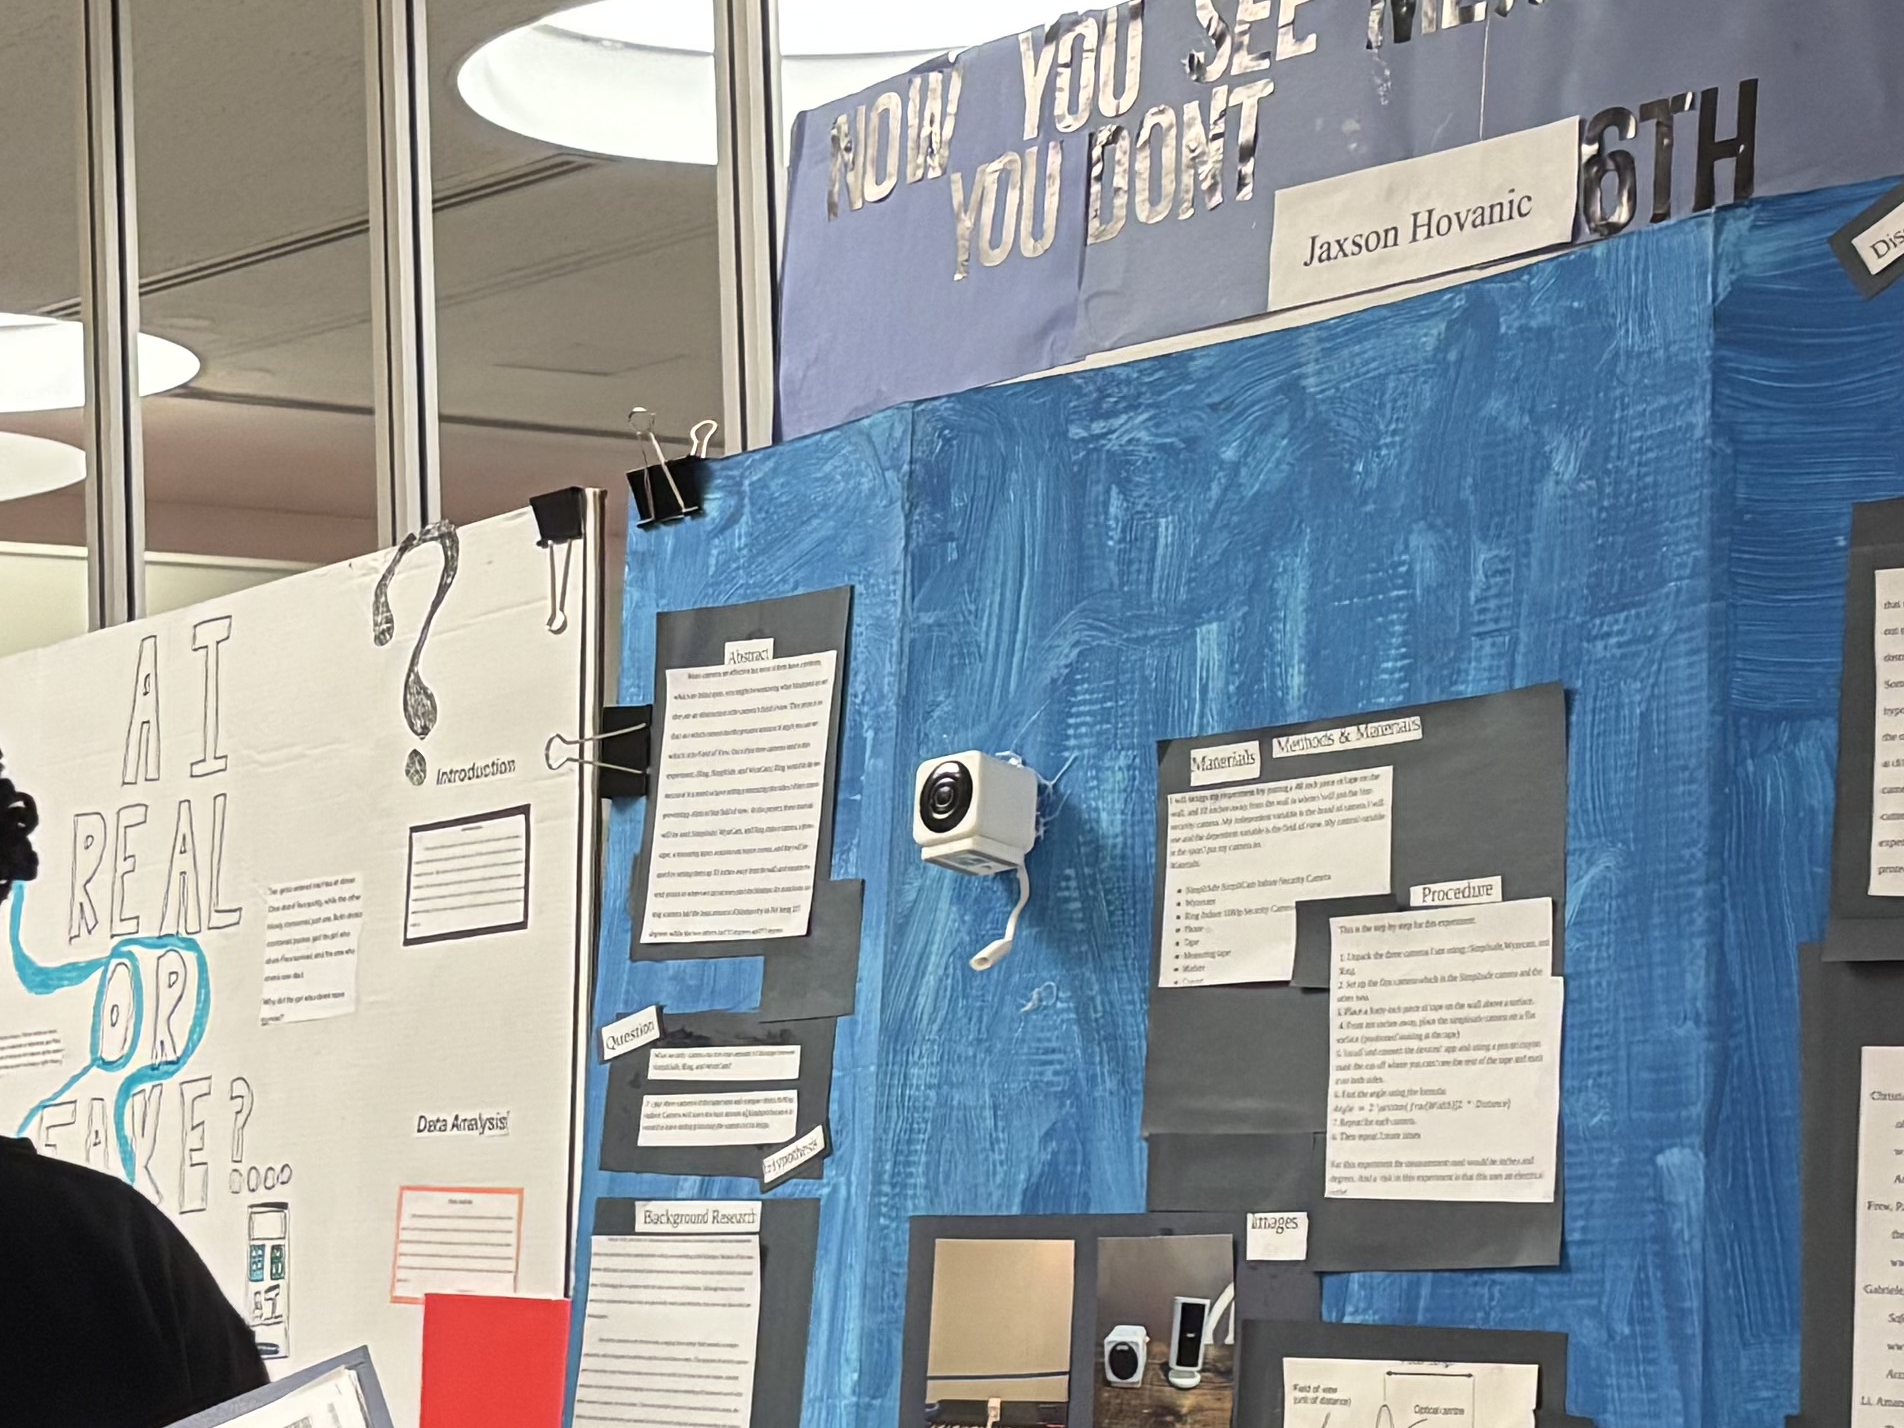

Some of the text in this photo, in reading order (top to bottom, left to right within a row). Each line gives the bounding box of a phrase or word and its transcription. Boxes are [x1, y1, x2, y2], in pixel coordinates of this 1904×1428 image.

[948, 79, 1759, 282] YOU DONT 6TH
[1302, 187, 1534, 269] Jaxson Hovanic
[728, 649, 770, 664] Abstract
[1278, 730, 1334, 756] Methods
[1339, 729, 1352, 742] &
[436, 759, 516, 787] Introduction
[1193, 751, 1256, 772] Materials
[68, 793, 242, 945] REAL
[1422, 882, 1494, 903] Procedure
[94, 949, 188, 1070] OR
[605, 1021, 654, 1051] Question
[416, 1111, 508, 1135] Data Analysis
[644, 1210, 708, 1227] Background
[1251, 1212, 1299, 1234] Images
